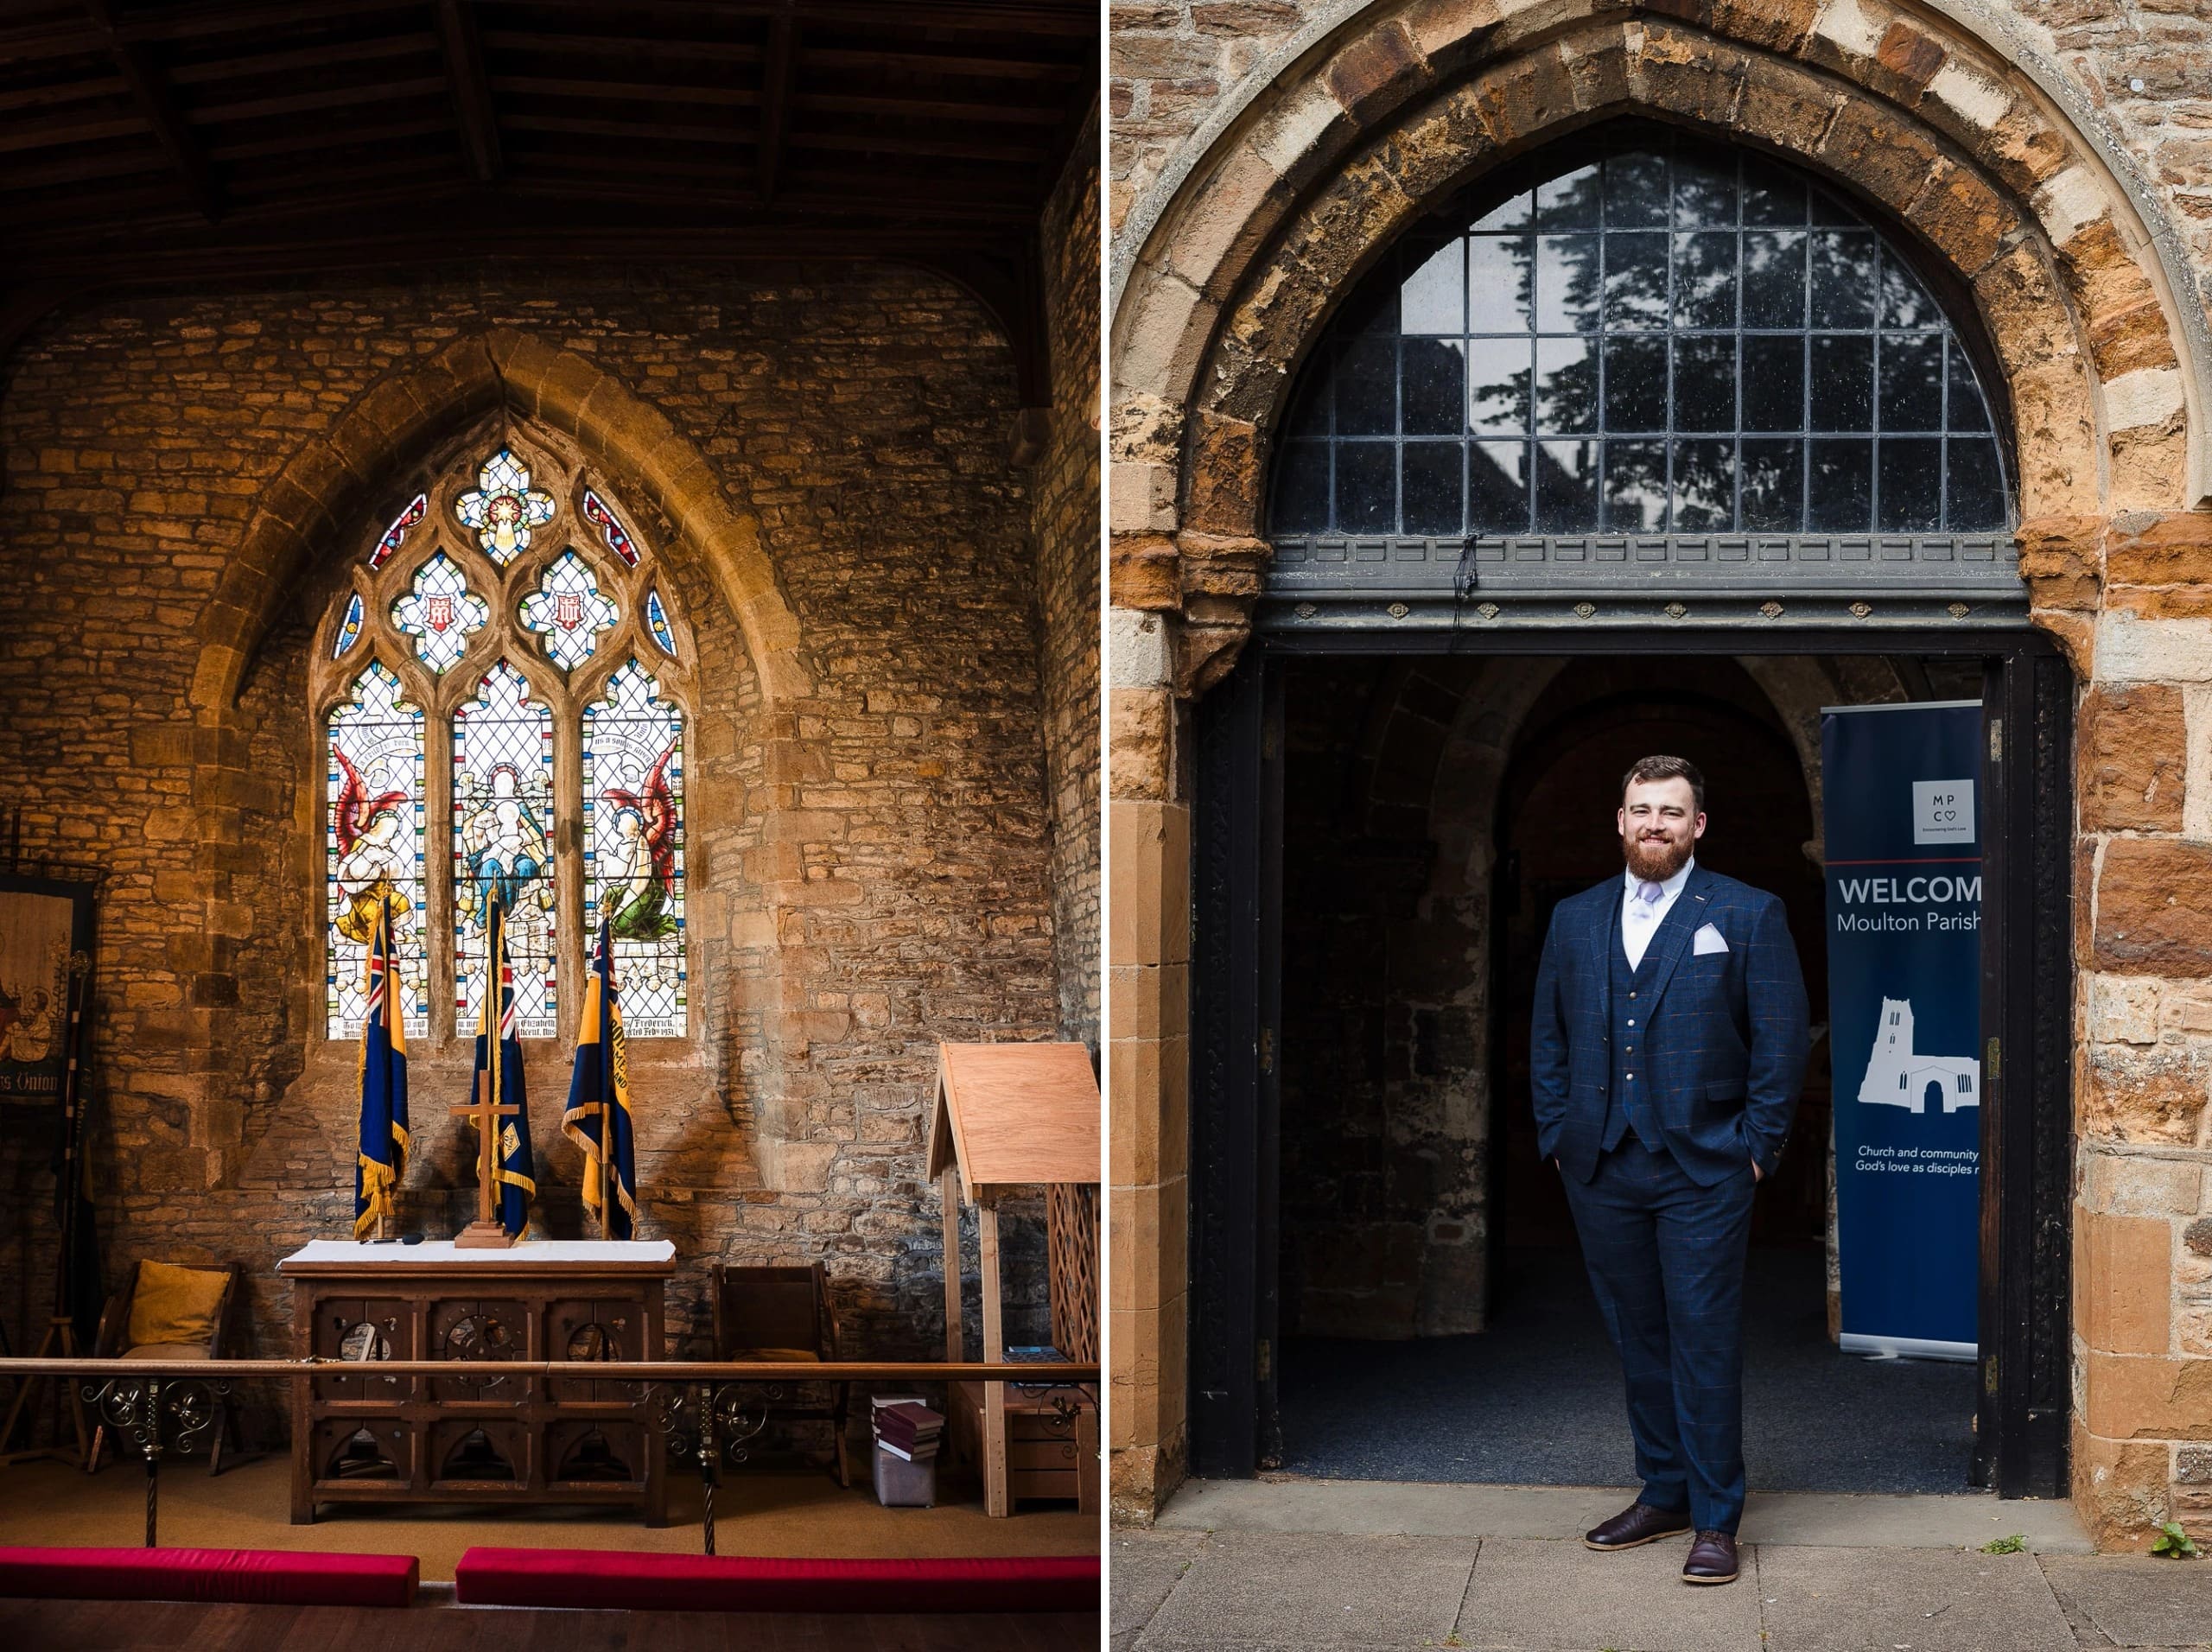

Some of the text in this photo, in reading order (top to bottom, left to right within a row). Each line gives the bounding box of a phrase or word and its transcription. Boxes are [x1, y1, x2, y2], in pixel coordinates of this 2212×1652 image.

[1838, 876, 1981, 904] WELCOM
[1838, 912, 1919, 931] Moulton
[17, 1071, 57, 1090] Union
[1858, 1145, 1979, 1163] Church and community
[1888, 1161, 1910, 1172] love
[1912, 1164, 1924, 1172] as
[1927, 1162, 1973, 1177] disciples
